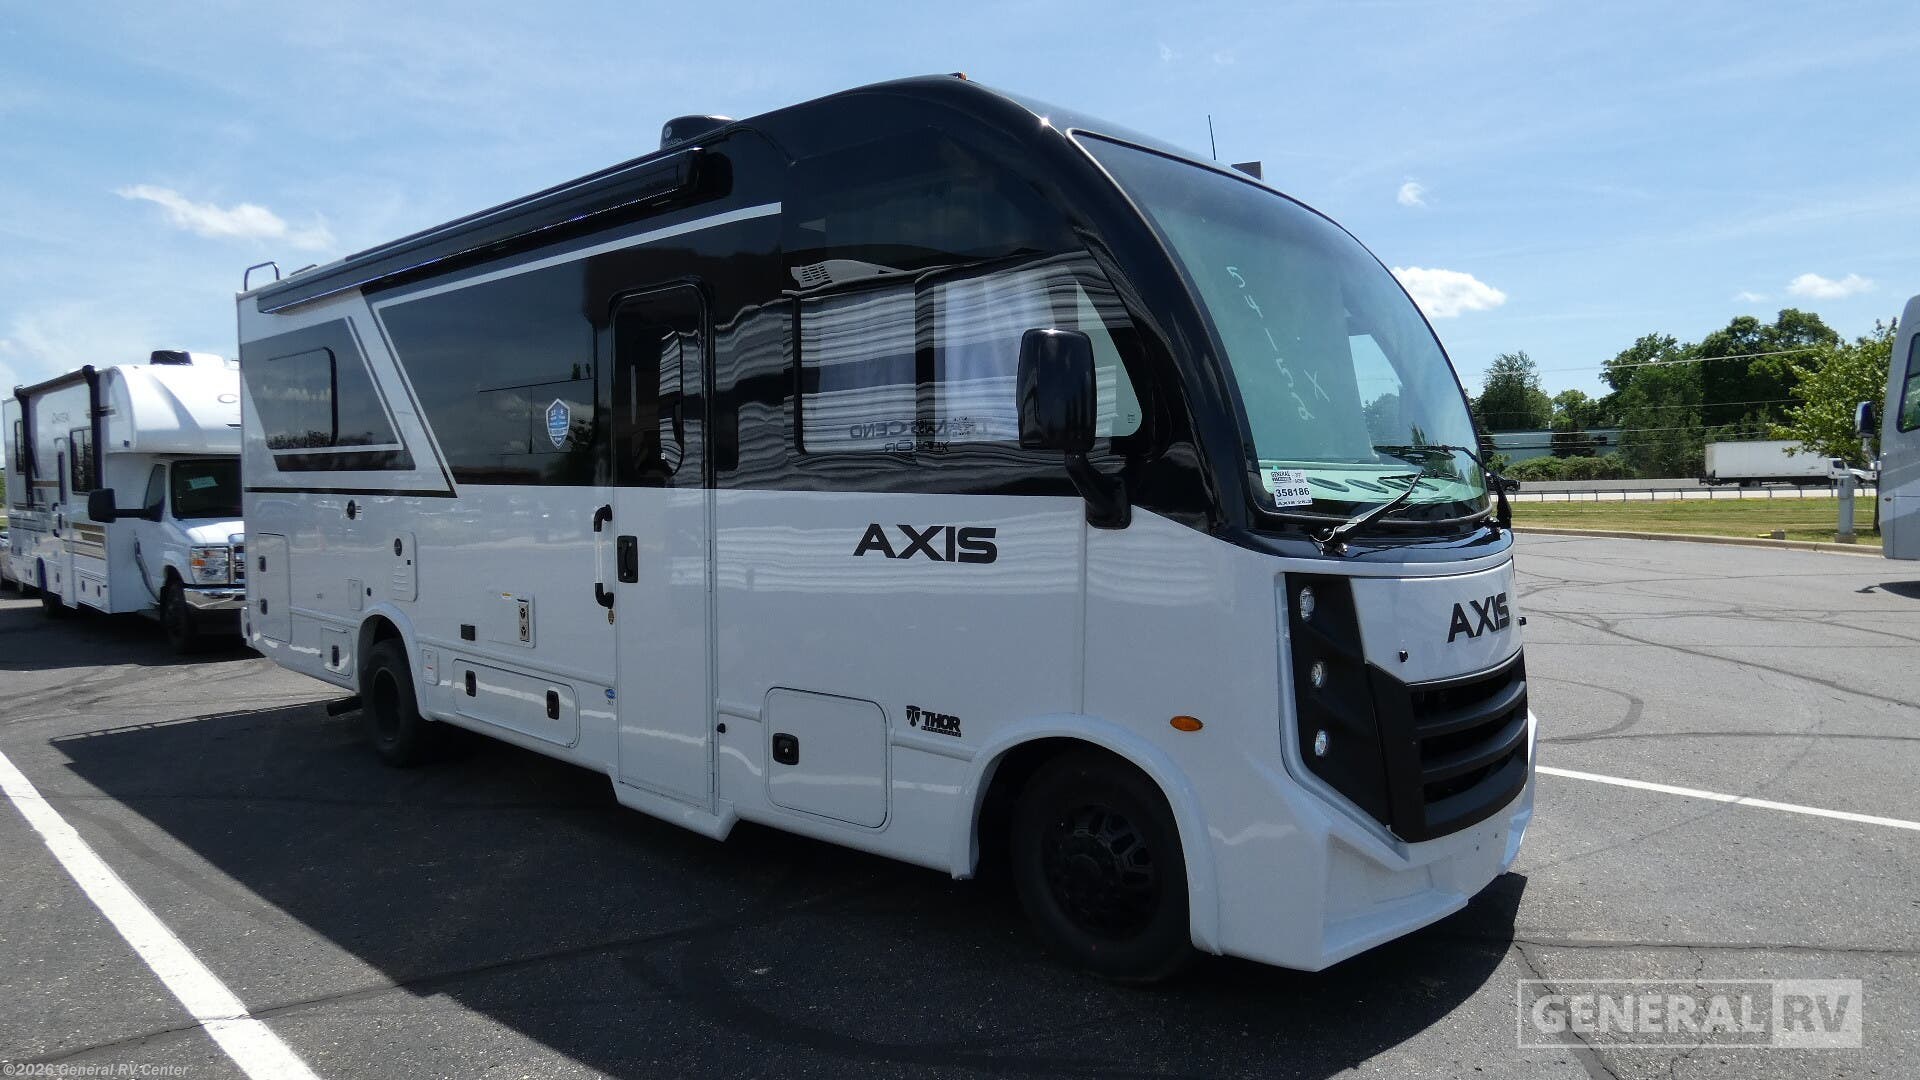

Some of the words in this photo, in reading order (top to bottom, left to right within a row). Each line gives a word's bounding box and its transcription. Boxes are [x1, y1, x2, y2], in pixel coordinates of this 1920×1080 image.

[1275, 487, 1310, 497] 358186
[852, 523, 998, 564] AXIS
[1447, 591, 1511, 643] AXIS
[921, 711, 960, 732] THOR
